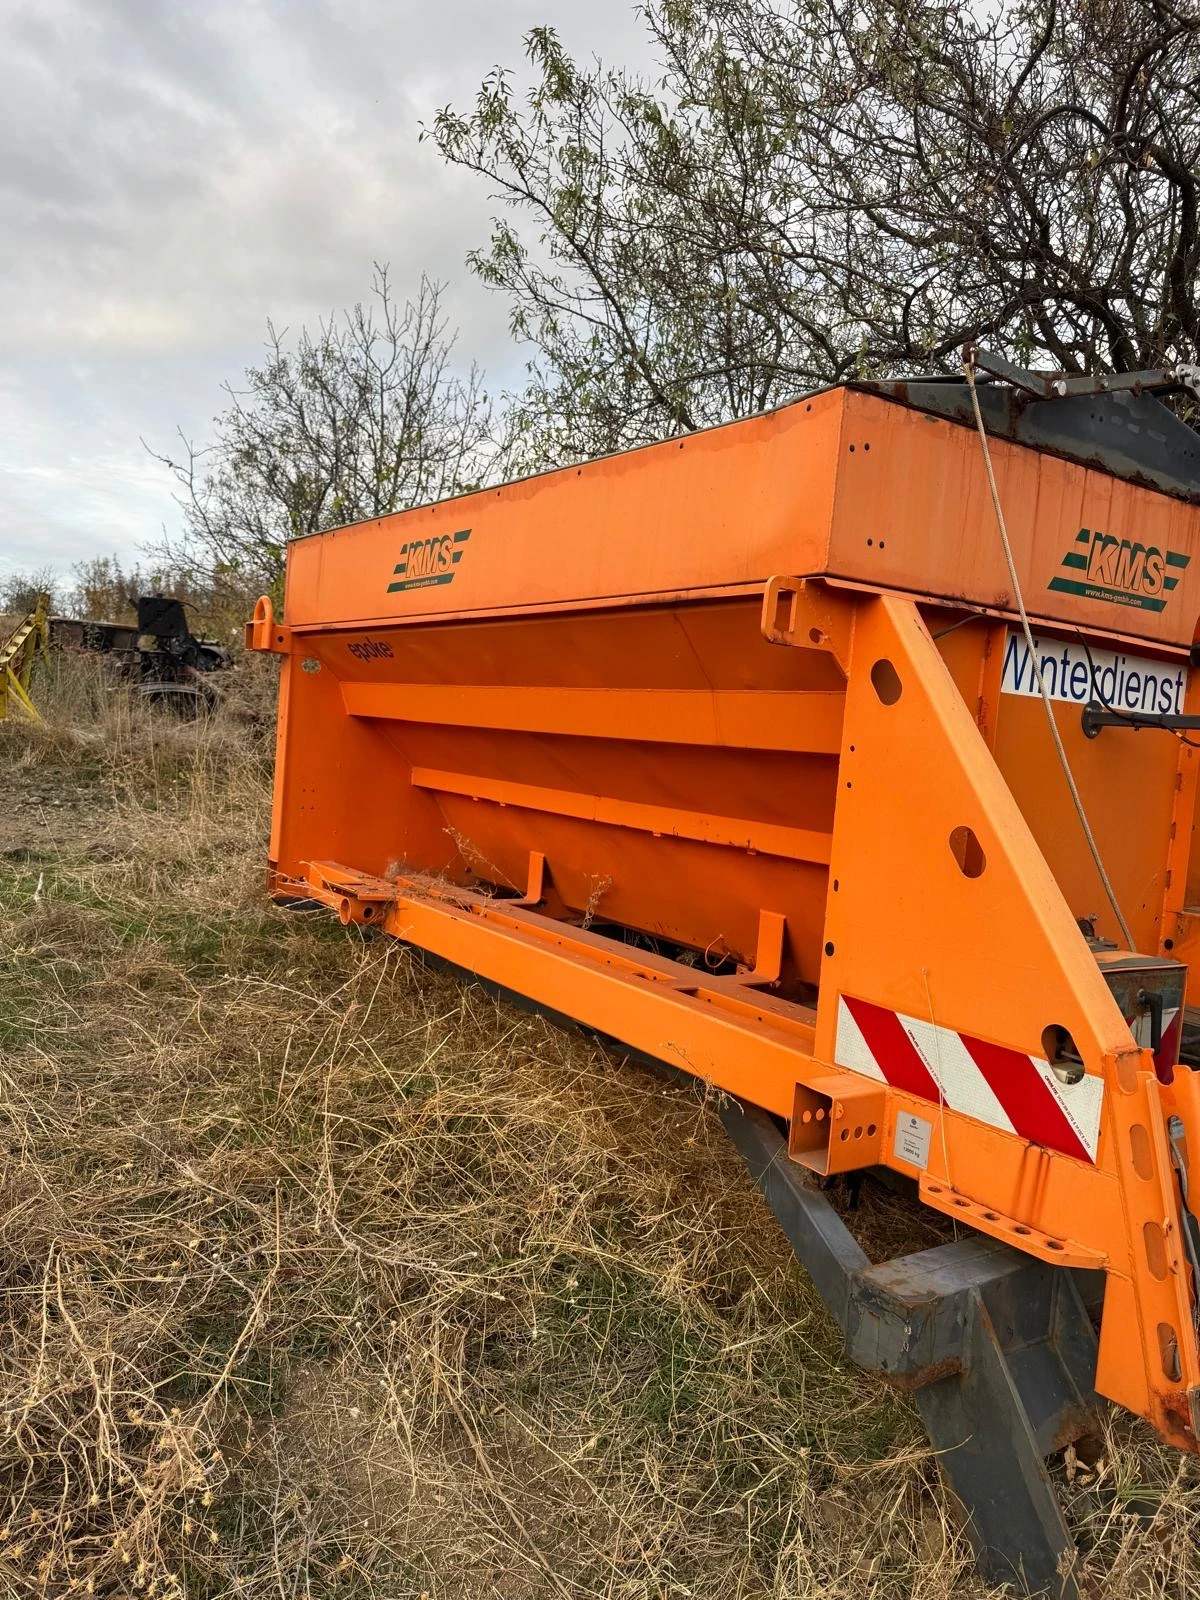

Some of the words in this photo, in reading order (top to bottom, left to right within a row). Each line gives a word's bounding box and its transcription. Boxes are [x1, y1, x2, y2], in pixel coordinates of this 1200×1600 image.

[405, 535, 453, 578] KMS
[1086, 532, 1165, 595] KMS
[348, 637, 394, 663] epoke
